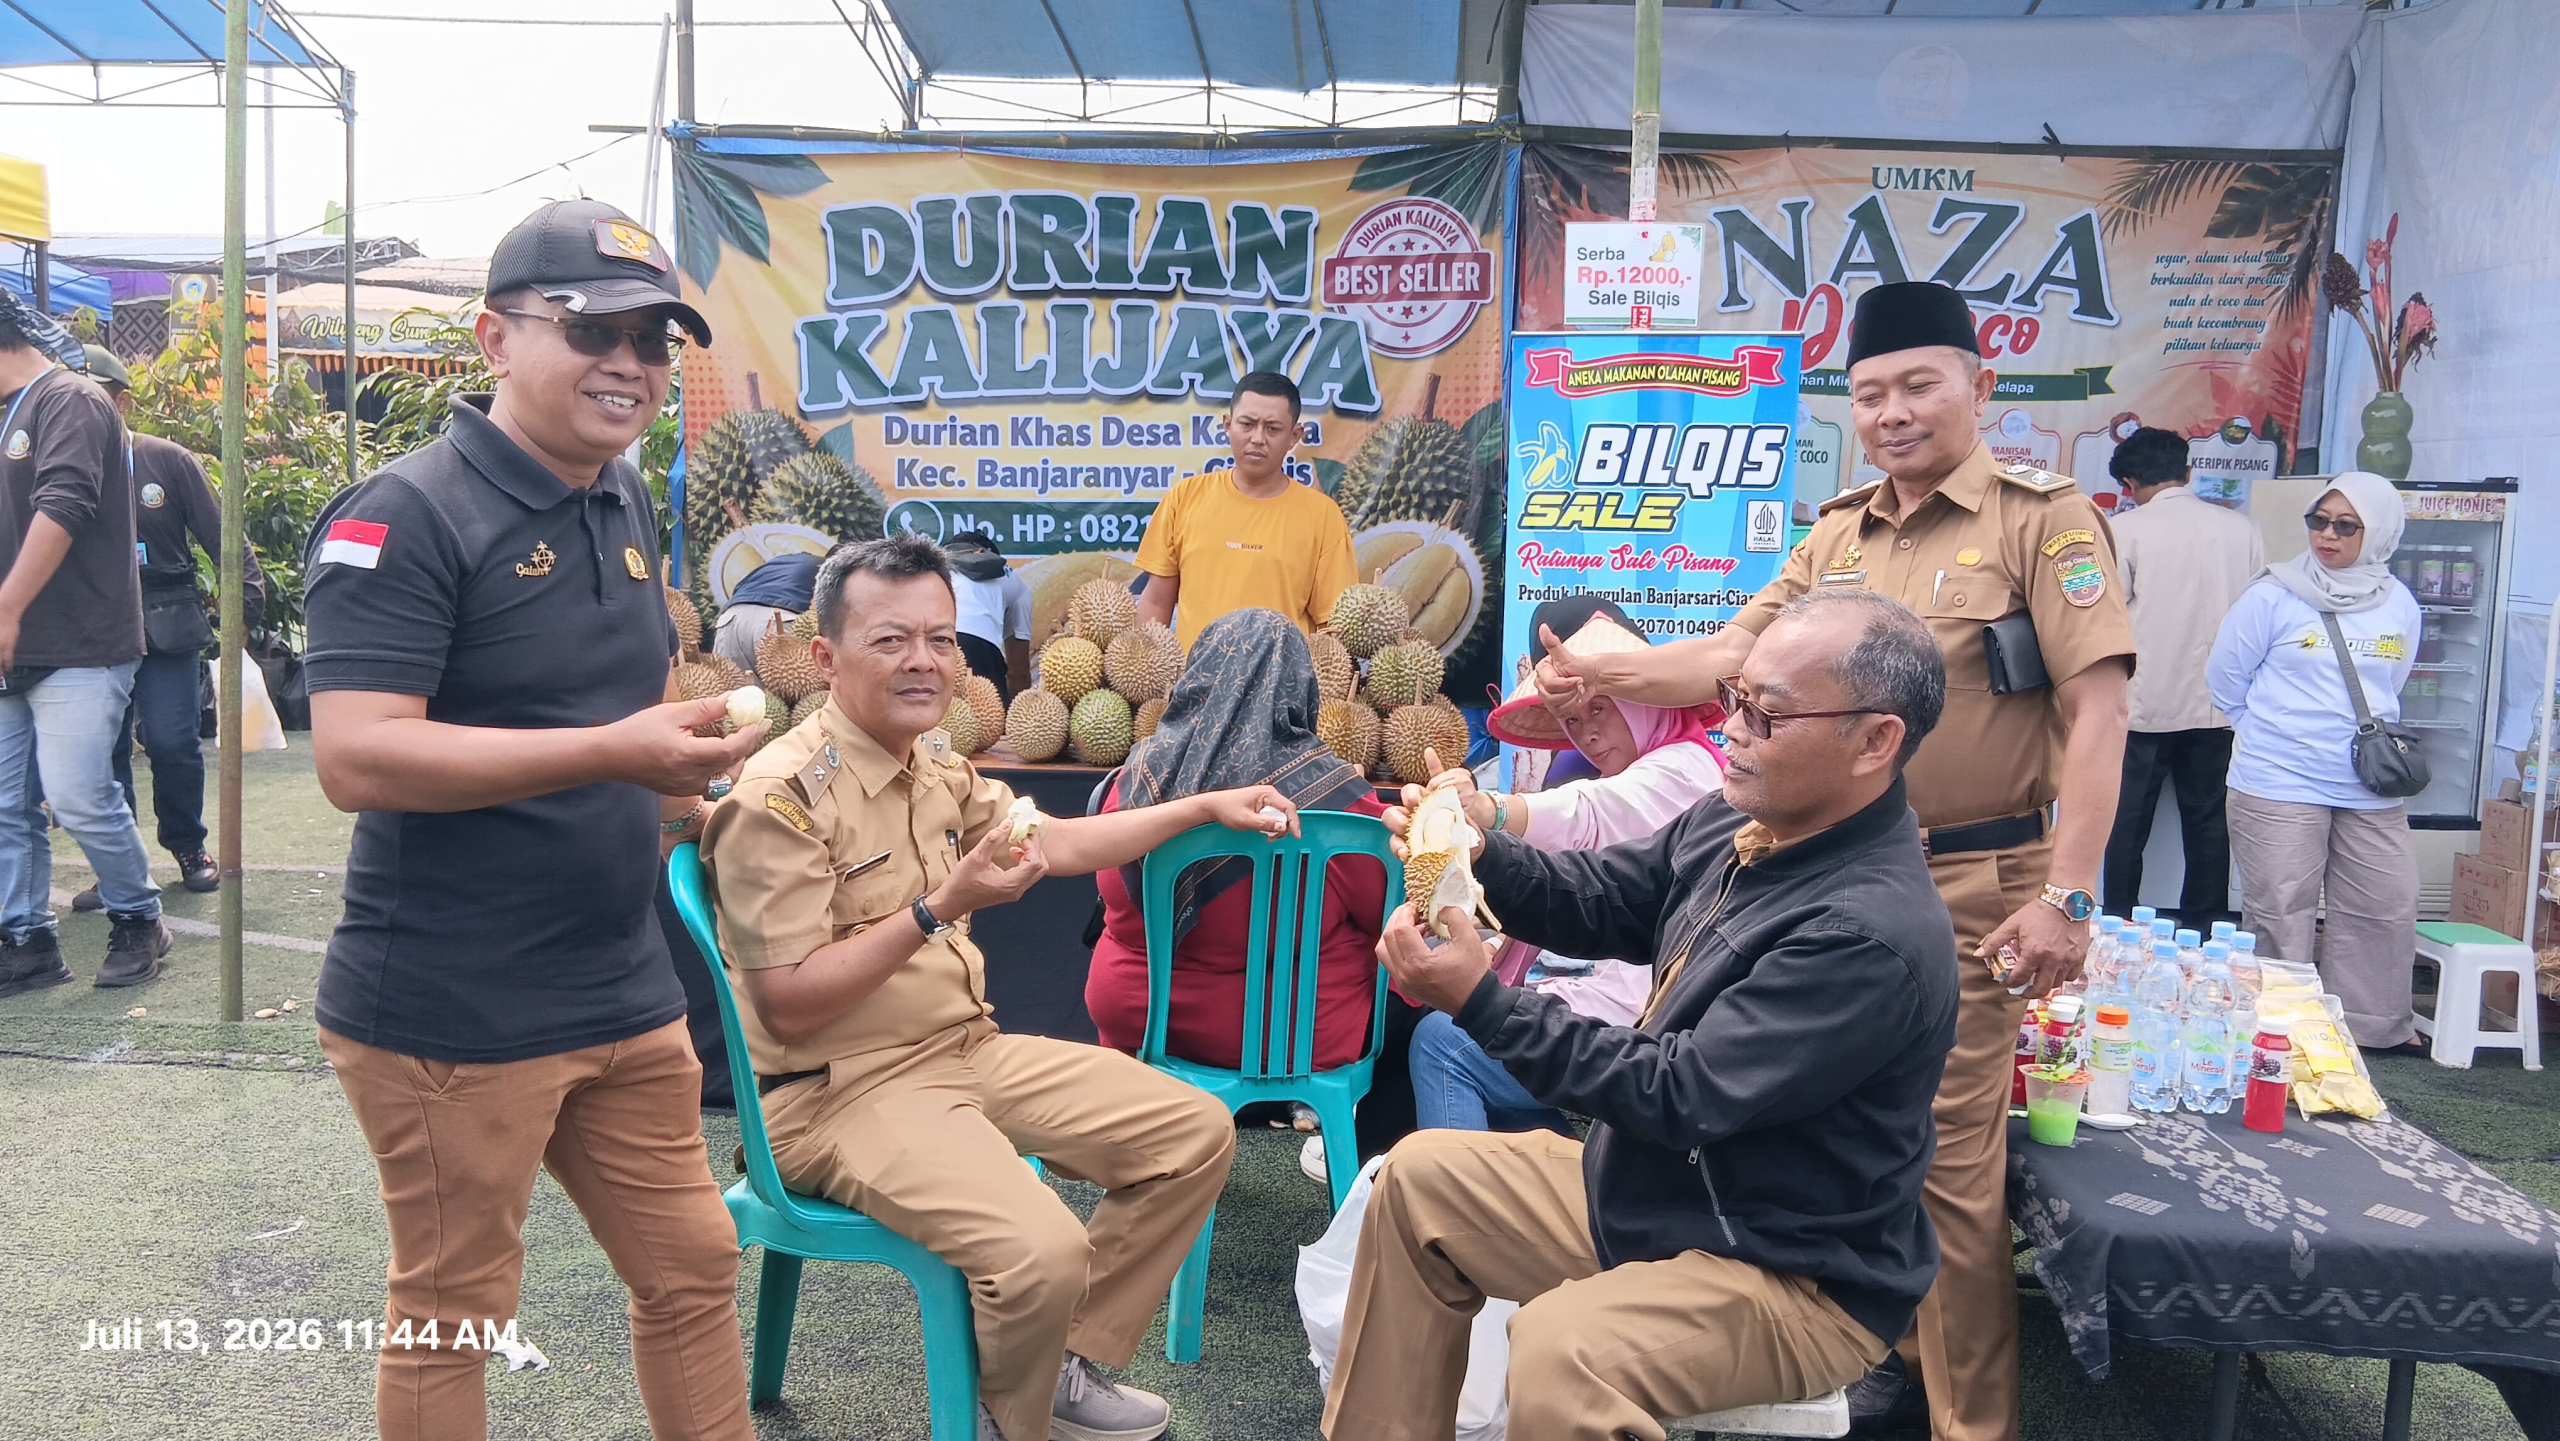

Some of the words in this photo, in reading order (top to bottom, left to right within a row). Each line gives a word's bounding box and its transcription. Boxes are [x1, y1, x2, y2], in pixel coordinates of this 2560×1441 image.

[1871, 166, 1976, 192] UMKM
[1356, 212, 1402, 248] DURIAN
[1405, 210, 1461, 247] KALIJAYA
[823, 191, 1318, 303] DURIAN
[1577, 247, 1625, 261] Serba
[1710, 192, 2119, 324] NAZA
[2155, 253, 2190, 268] segar,
[2195, 250, 2229, 264] alami
[2233, 250, 2263, 264] sehat
[2265, 250, 2290, 264] dan
[1334, 264, 1392, 295] BEST
[1399, 261, 1480, 293] SELLER
[1577, 266, 1692, 288] Rp.12000,-
[2150, 272, 2214, 286] berkualitas
[2218, 272, 2245, 285] dari
[1588, 290, 1627, 305] Sale
[1633, 290, 1680, 309] Bilqis
[2169, 294, 2196, 307] nata
[2200, 294, 2214, 307] de
[2217, 298, 2240, 307] coco
[2243, 294, 2267, 307] dan
[2163, 316, 2193, 329] buah
[2197, 316, 2267, 334] kecombrang
[797, 300, 1379, 411] KALIJAYA
[2163, 338, 2206, 355] pilihan
[2210, 338, 2262, 355] keluarga
[1567, 369, 1602, 387] ANEKA
[1603, 365, 1656, 383] MAKANAN
[1657, 365, 1701, 382] OLAHAN
[1701, 369, 1741, 386] PISANG
[1799, 373, 1825, 386] han
[884, 415, 1000, 447] Durian
[1010, 416, 1092, 447] Khas
[1102, 415, 1182, 447] Desa
[1800, 450, 1829, 464] COCO
[1991, 446, 2032, 456] MANISAN
[1574, 423, 1788, 499] BILQIS
[2191, 457, 2232, 470] KERIPIK
[2234, 458, 2269, 472] PISANG
[896, 458, 966, 488] Kec.
[977, 457, 1175, 496] Banjaranyar
[1517, 491, 1685, 532] SALE
[2419, 496, 2451, 512] JUICE
[2455, 497, 2492, 513] HONJE
[1012, 514, 1056, 543] HP
[1517, 541, 1605, 576] Ratunya
[1609, 543, 1659, 572] Sale
[1661, 544, 1740, 576] Pisang
[1518, 584, 1570, 601] Produk
[2191, 1062, 2225, 1074] Minerale
[2202, 1057, 2213, 1066] Le
